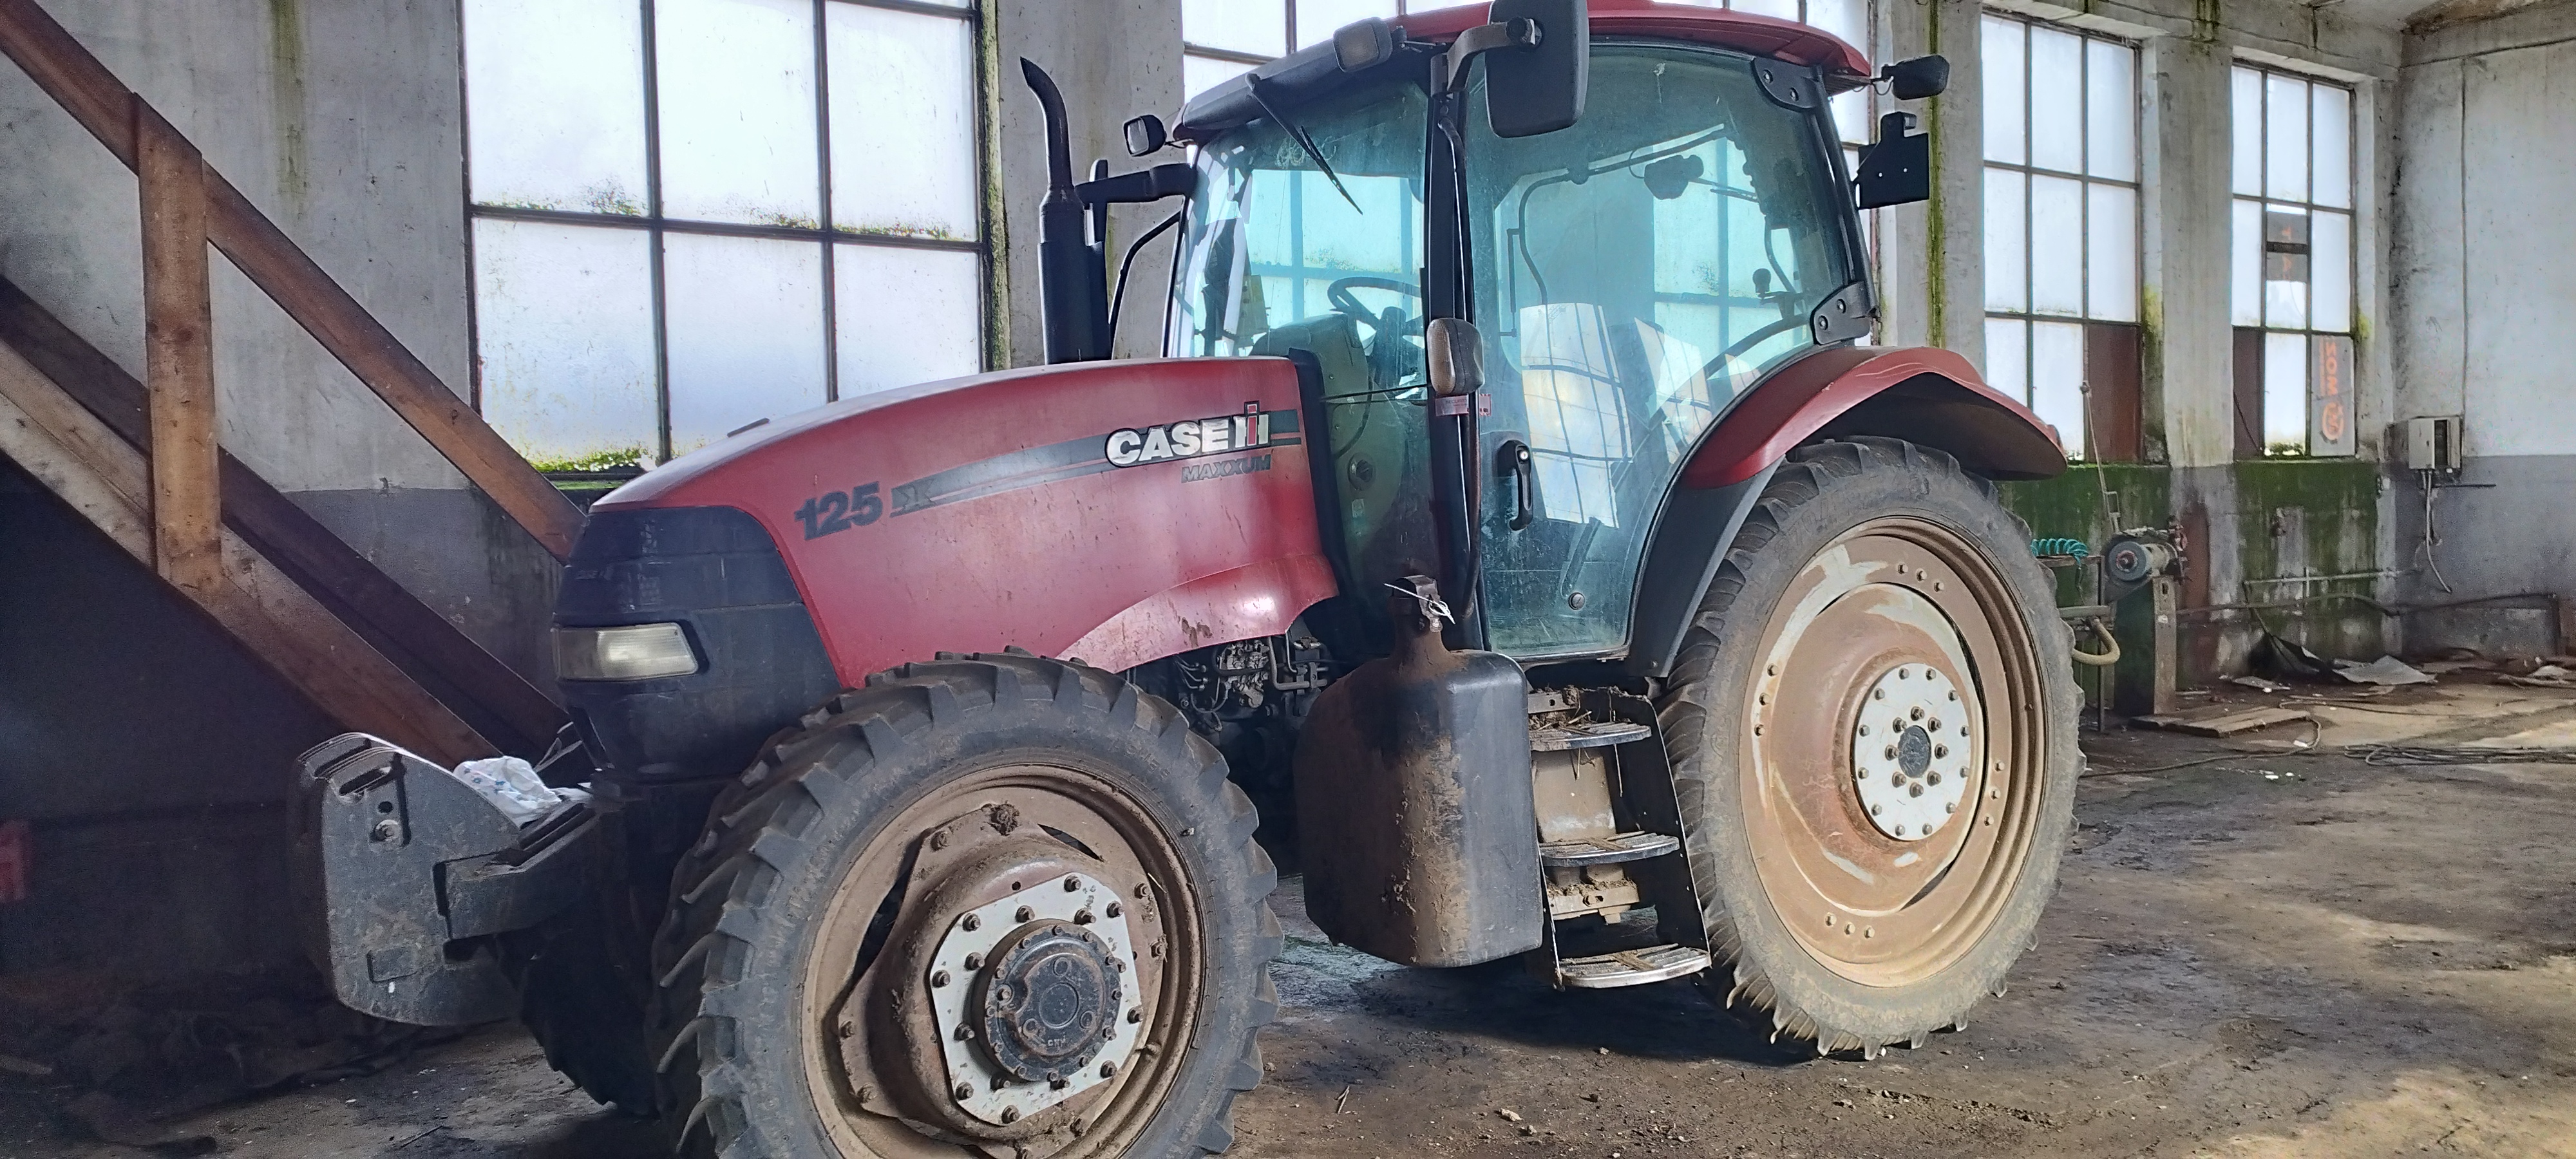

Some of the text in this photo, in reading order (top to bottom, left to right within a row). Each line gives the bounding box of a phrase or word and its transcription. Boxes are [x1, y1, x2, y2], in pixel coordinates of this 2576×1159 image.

[1107, 420, 1229, 464] CASE
[1181, 454, 1271, 483] MAXXUM
[794, 481, 883, 541] 125
